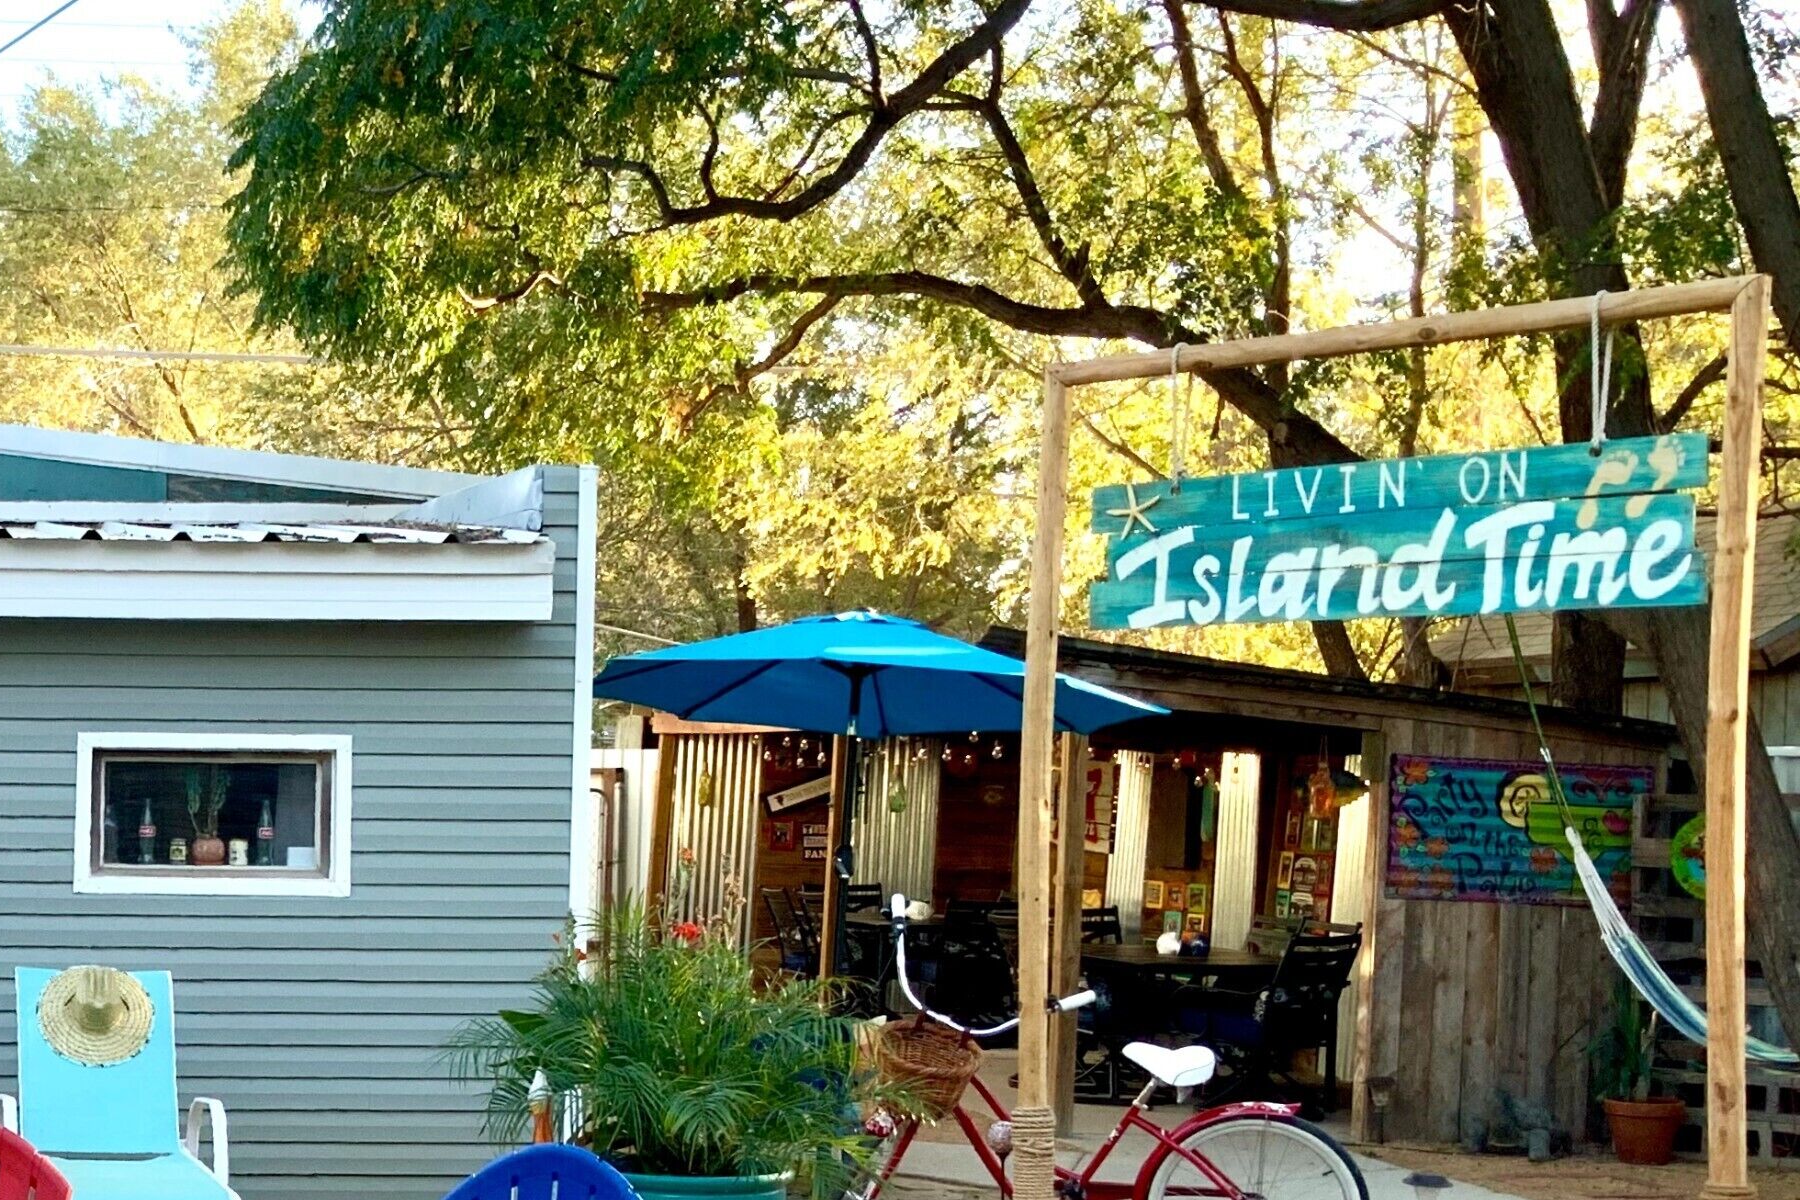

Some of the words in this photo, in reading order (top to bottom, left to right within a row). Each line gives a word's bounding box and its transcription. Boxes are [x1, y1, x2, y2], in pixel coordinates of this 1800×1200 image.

[1458, 450, 1529, 505] ON
[1114, 506, 1459, 629] Island
[1463, 500, 1693, 615] Time
[1401, 773, 1487, 839] Party
[1452, 851, 1537, 894] Patio
